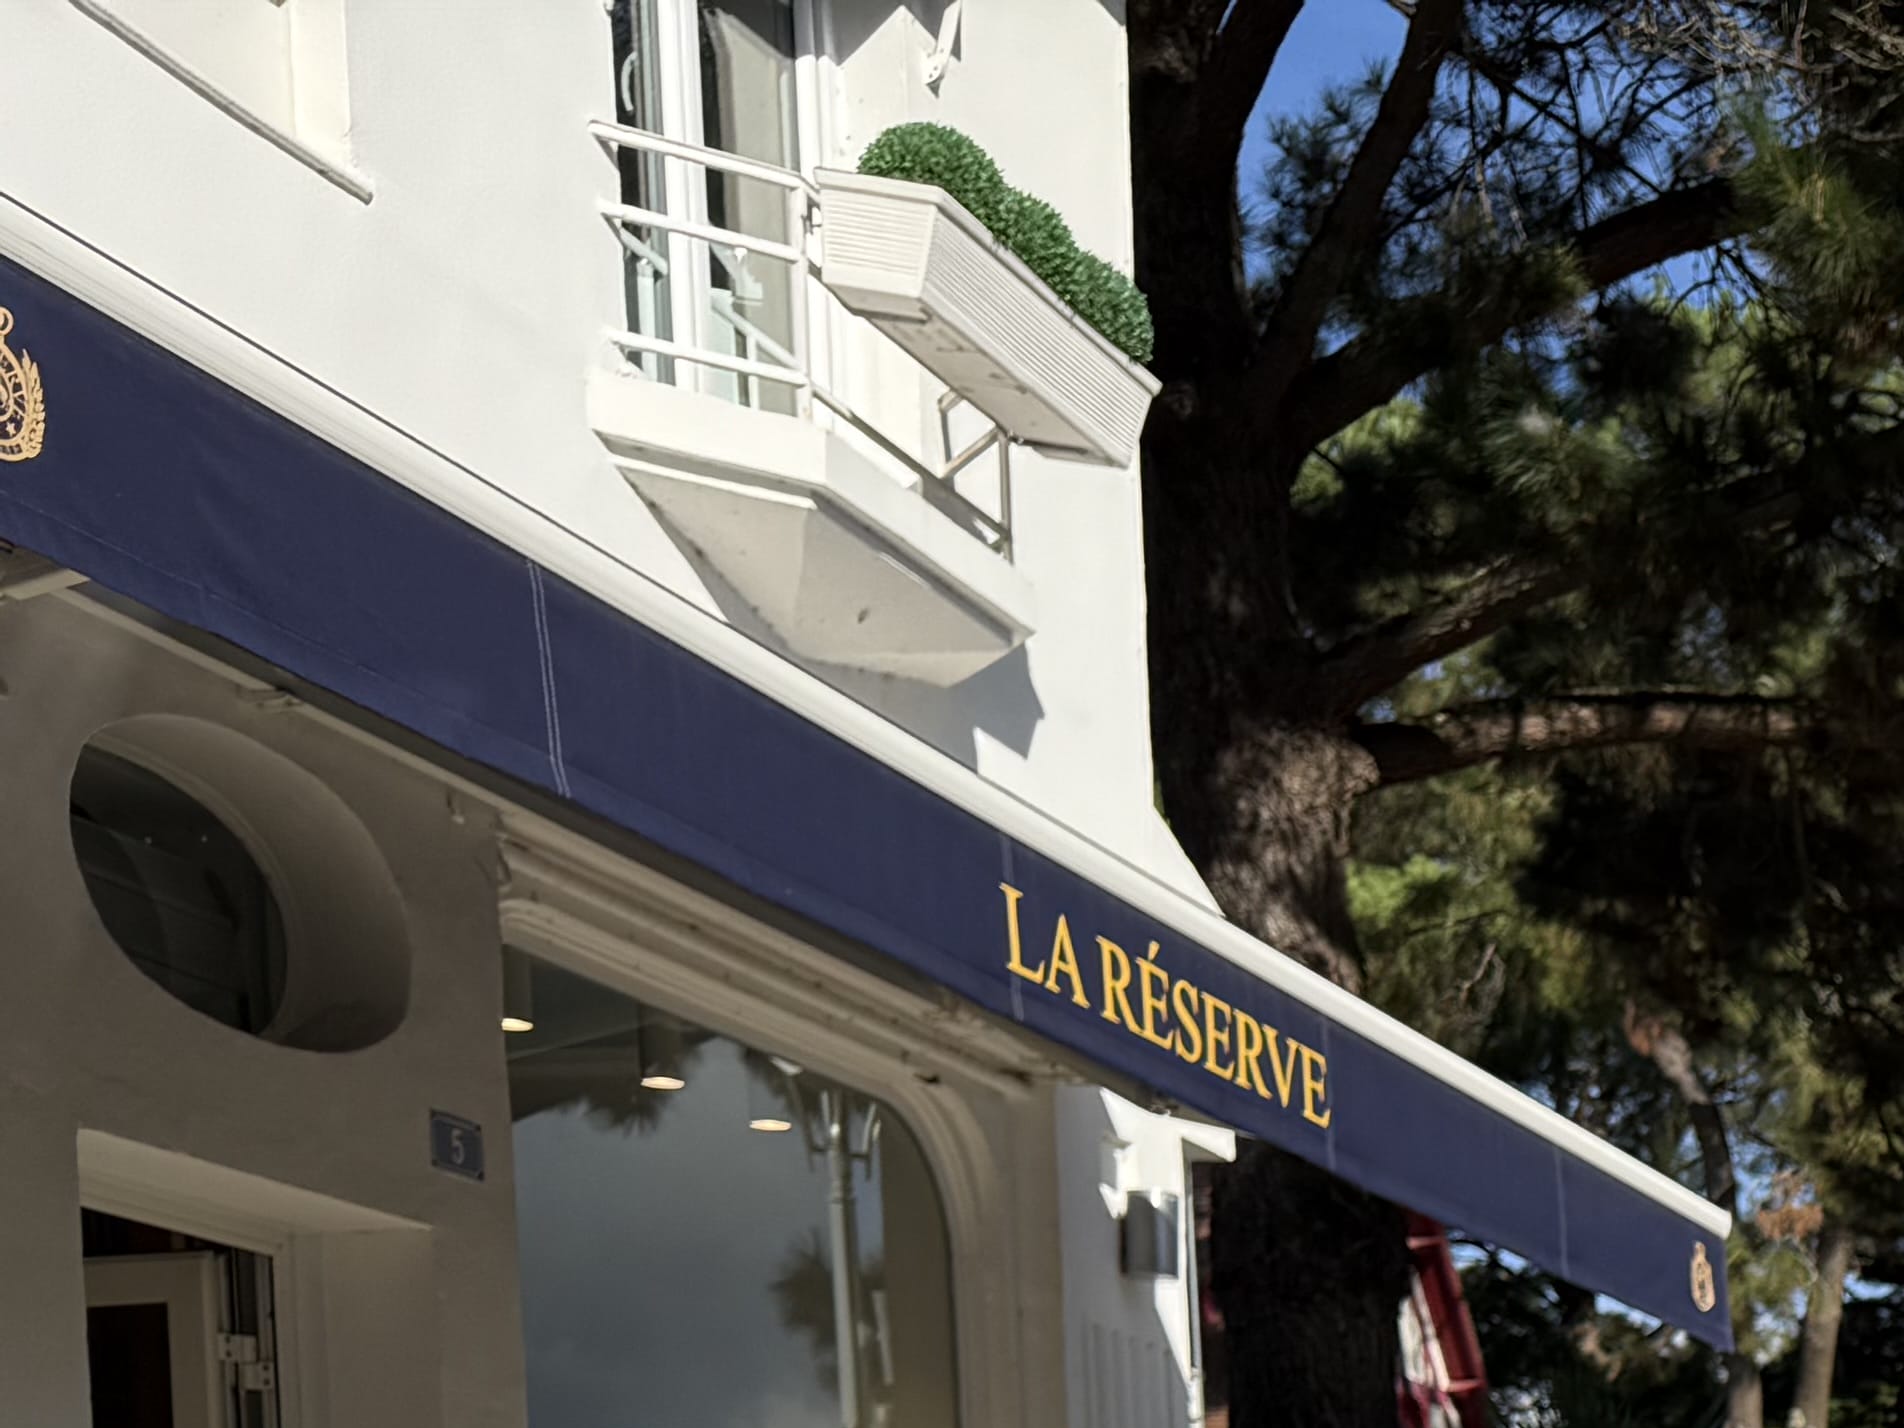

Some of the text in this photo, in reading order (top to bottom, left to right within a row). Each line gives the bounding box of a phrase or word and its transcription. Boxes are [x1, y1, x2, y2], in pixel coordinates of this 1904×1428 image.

[999, 882, 1331, 1129] LA RÉSERVE
[450, 1127, 465, 1165] 5
